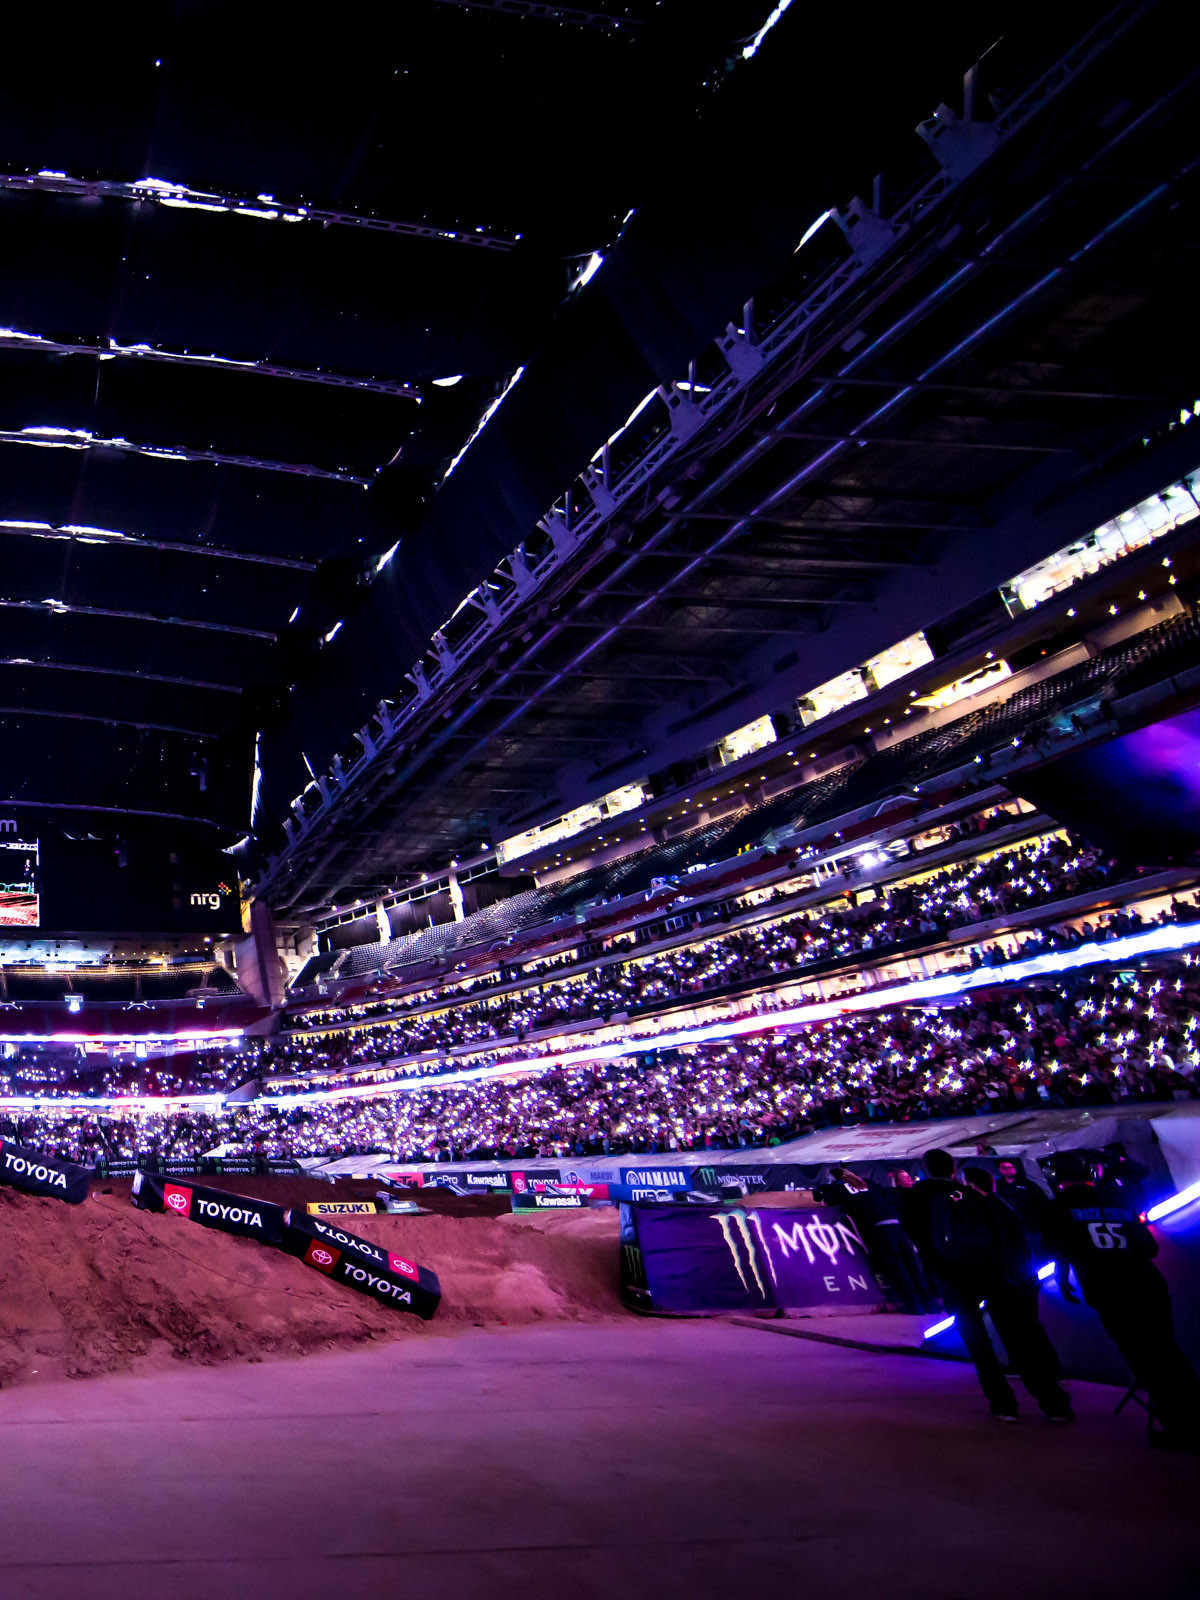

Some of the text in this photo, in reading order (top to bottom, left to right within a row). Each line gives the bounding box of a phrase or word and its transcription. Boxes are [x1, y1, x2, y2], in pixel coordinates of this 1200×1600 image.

[190, 892, 221, 910] nrg
[5, 1153, 67, 1189] TOYOTA
[638, 1171, 686, 1186] YAMAHA
[717, 1174, 766, 1186] MONSTER
[467, 1174, 507, 1187] Kawasaki
[317, 1204, 370, 1214] SUZUKI
[535, 1195, 581, 1206] Kawasaki
[197, 1199, 263, 1228] TOYOTA
[314, 1222, 383, 1261] TOYOTA
[1087, 1222, 1128, 1249] 65
[344, 1262, 412, 1305] TOYOTA
